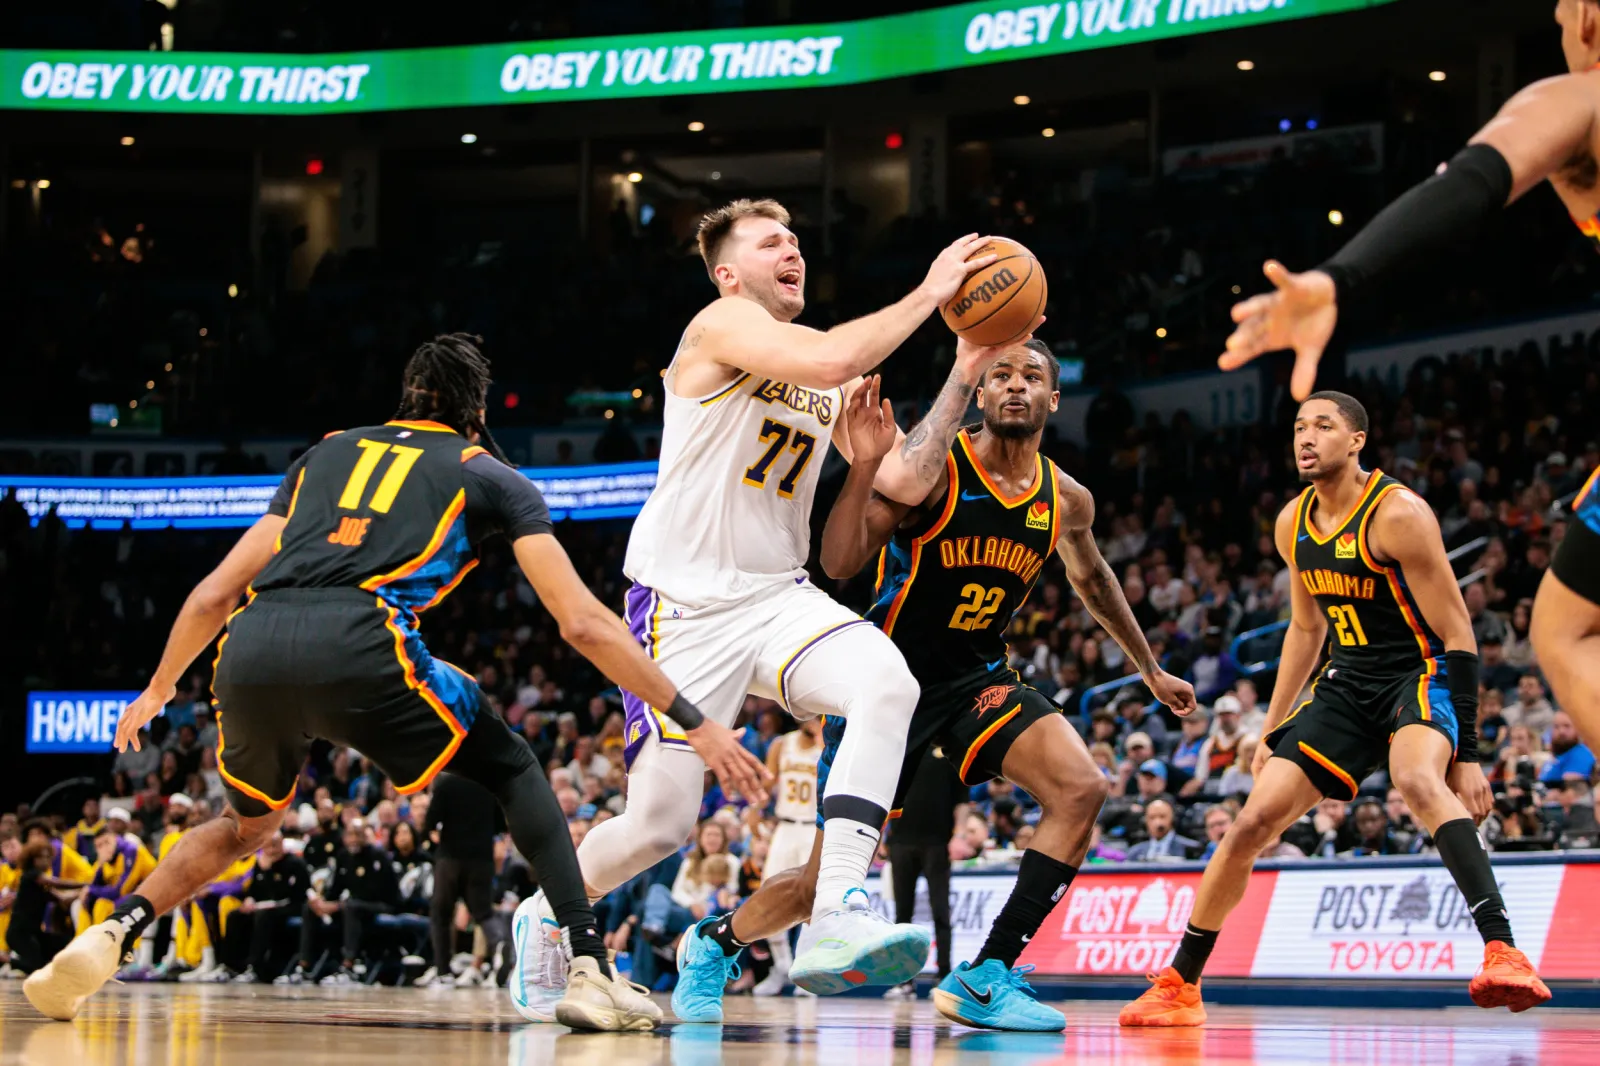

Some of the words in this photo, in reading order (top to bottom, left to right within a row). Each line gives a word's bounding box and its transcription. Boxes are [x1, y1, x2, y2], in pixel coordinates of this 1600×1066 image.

[965, 3, 1060, 54] OBEY
[21, 62, 126, 99] OBEY
[128, 63, 234, 101] YOUR
[239, 64, 370, 103] THIRST
[500, 51, 601, 92] OBEY
[602, 45, 704, 86] YOUR
[709, 35, 843, 81] THIRST
[952, 267, 1018, 318] Wilson
[751, 378, 833, 427] LAKERS
[338, 438, 425, 514] 11
[742, 416, 817, 500] 77
[327, 516, 372, 546] JOE
[1027, 517, 1048, 529] Love's
[940, 535, 1044, 584] OKLAHOMA
[948, 583, 1006, 631] 22
[1327, 604, 1368, 646] 21
[32, 700, 128, 743] HOME
[787, 779, 811, 804] 30
[1062, 886, 1137, 932] POST
[1313, 885, 1394, 930] POST
[1329, 942, 1455, 972] TOYOTA
